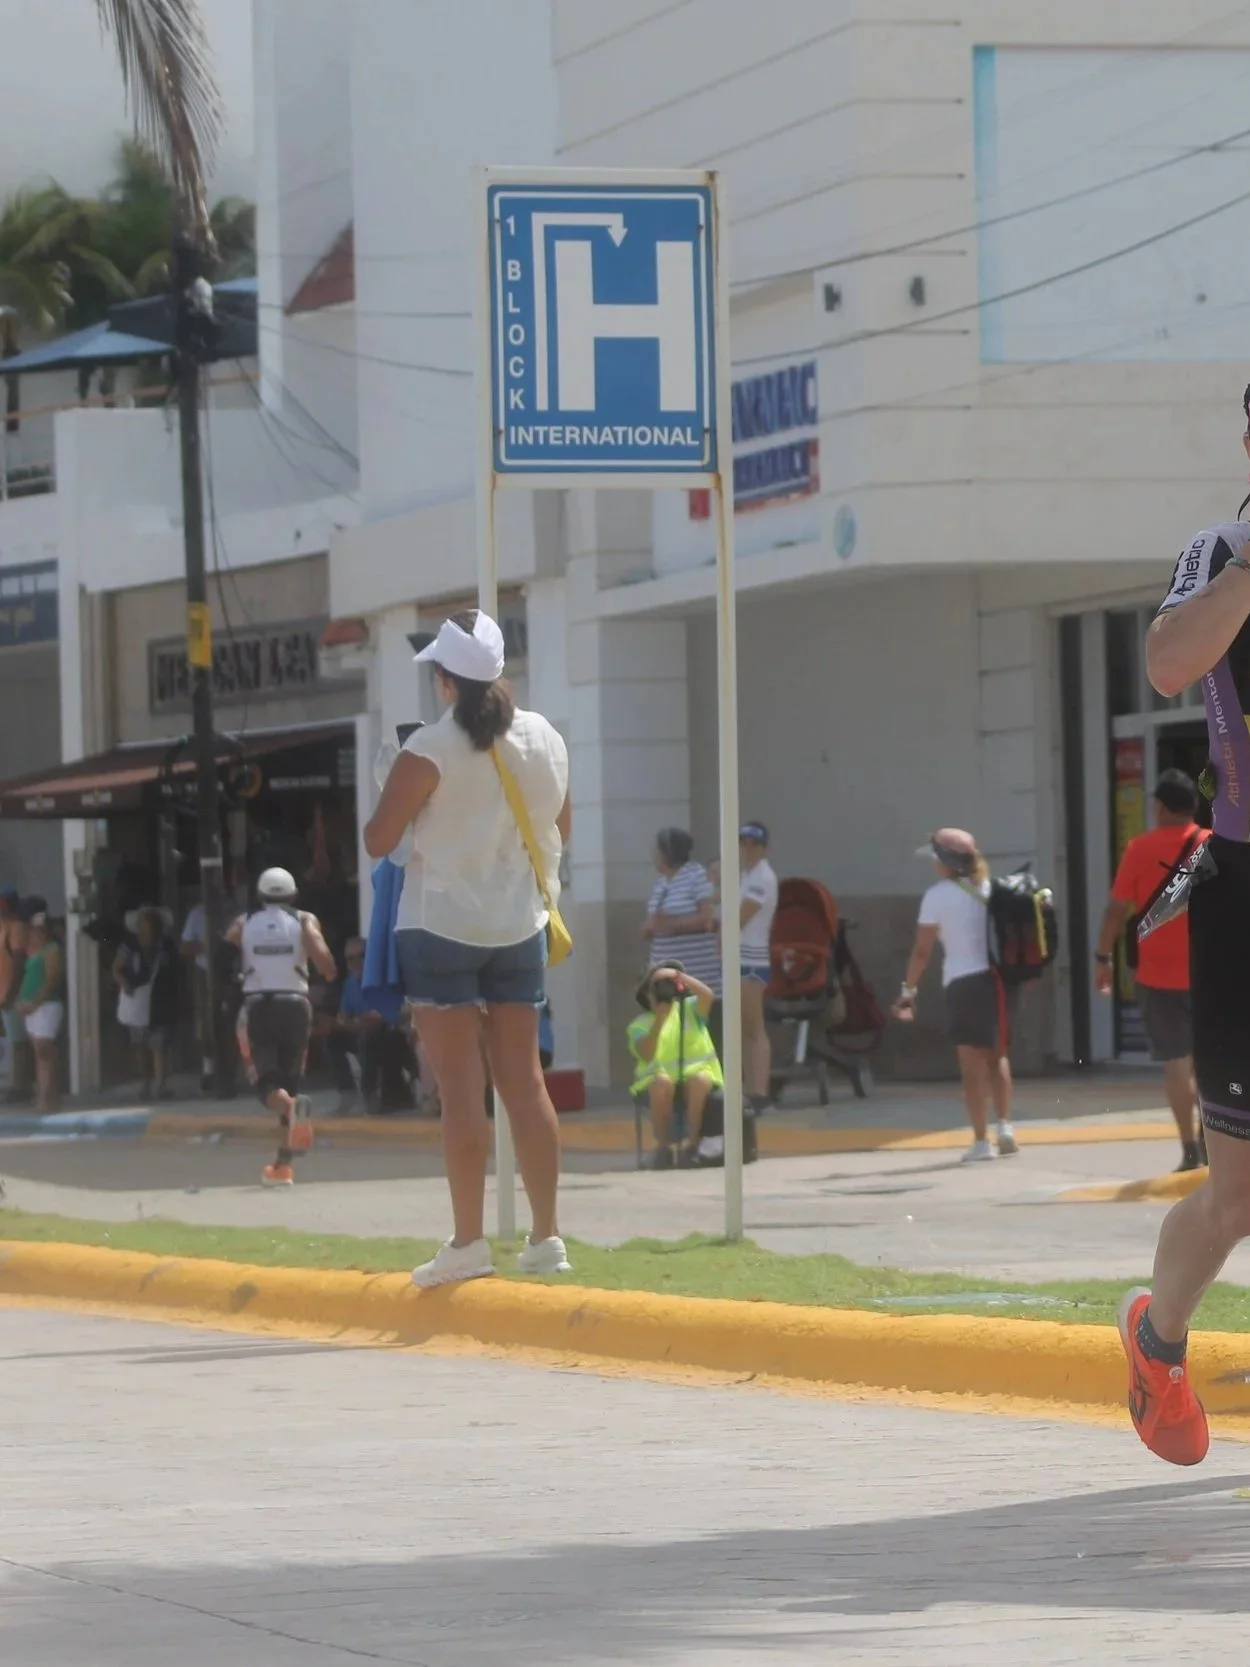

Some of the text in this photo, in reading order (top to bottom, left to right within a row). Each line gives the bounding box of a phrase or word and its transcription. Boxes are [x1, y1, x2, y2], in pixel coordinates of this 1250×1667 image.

[505, 214, 527, 411] 1 BLOCK
[554, 240, 697, 412] H
[509, 426, 700, 446] INTERNATIONAL
